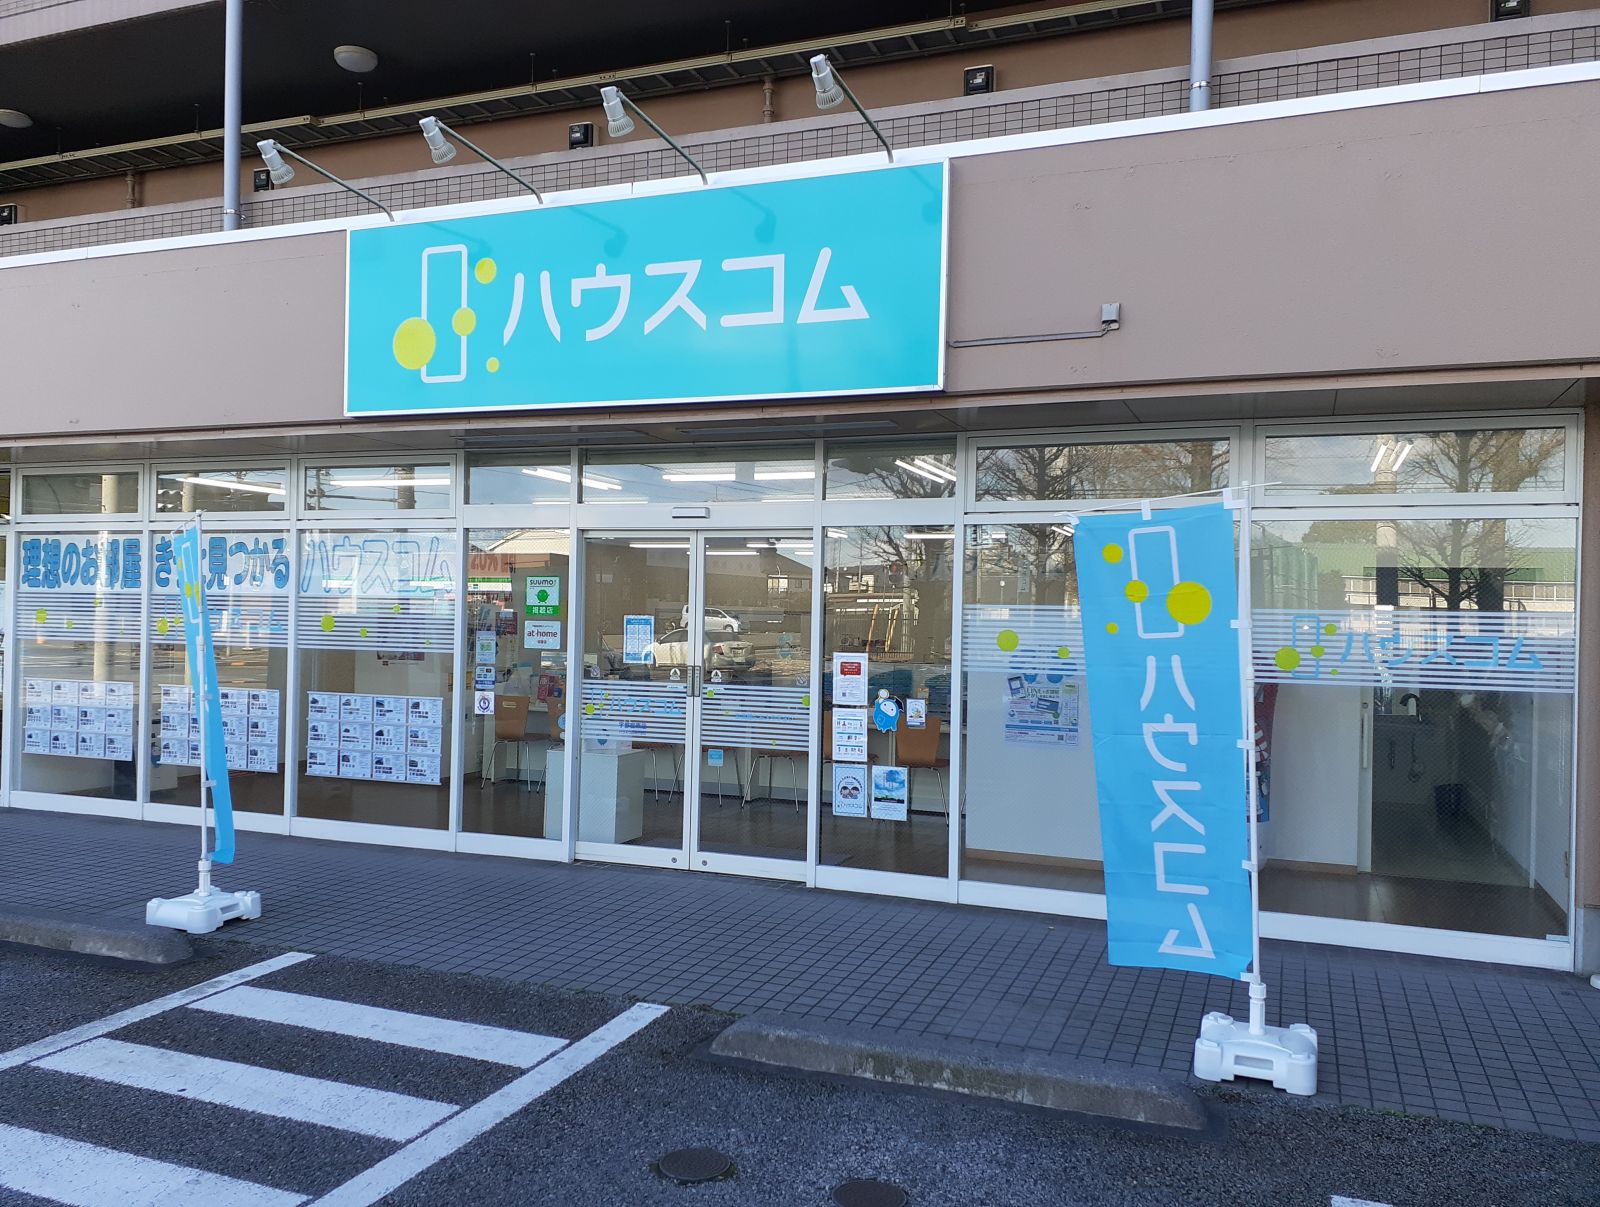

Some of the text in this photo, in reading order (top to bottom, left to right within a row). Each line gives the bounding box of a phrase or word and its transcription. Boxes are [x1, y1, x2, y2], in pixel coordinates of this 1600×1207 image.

[503, 246, 870, 347] ハウスコム
[22, 535, 453, 594] 理想のお部屋 き見つかる ハウスコム
[1340, 631, 1545, 670] ハウスコム
[609, 697, 683, 715] ハウスコム
